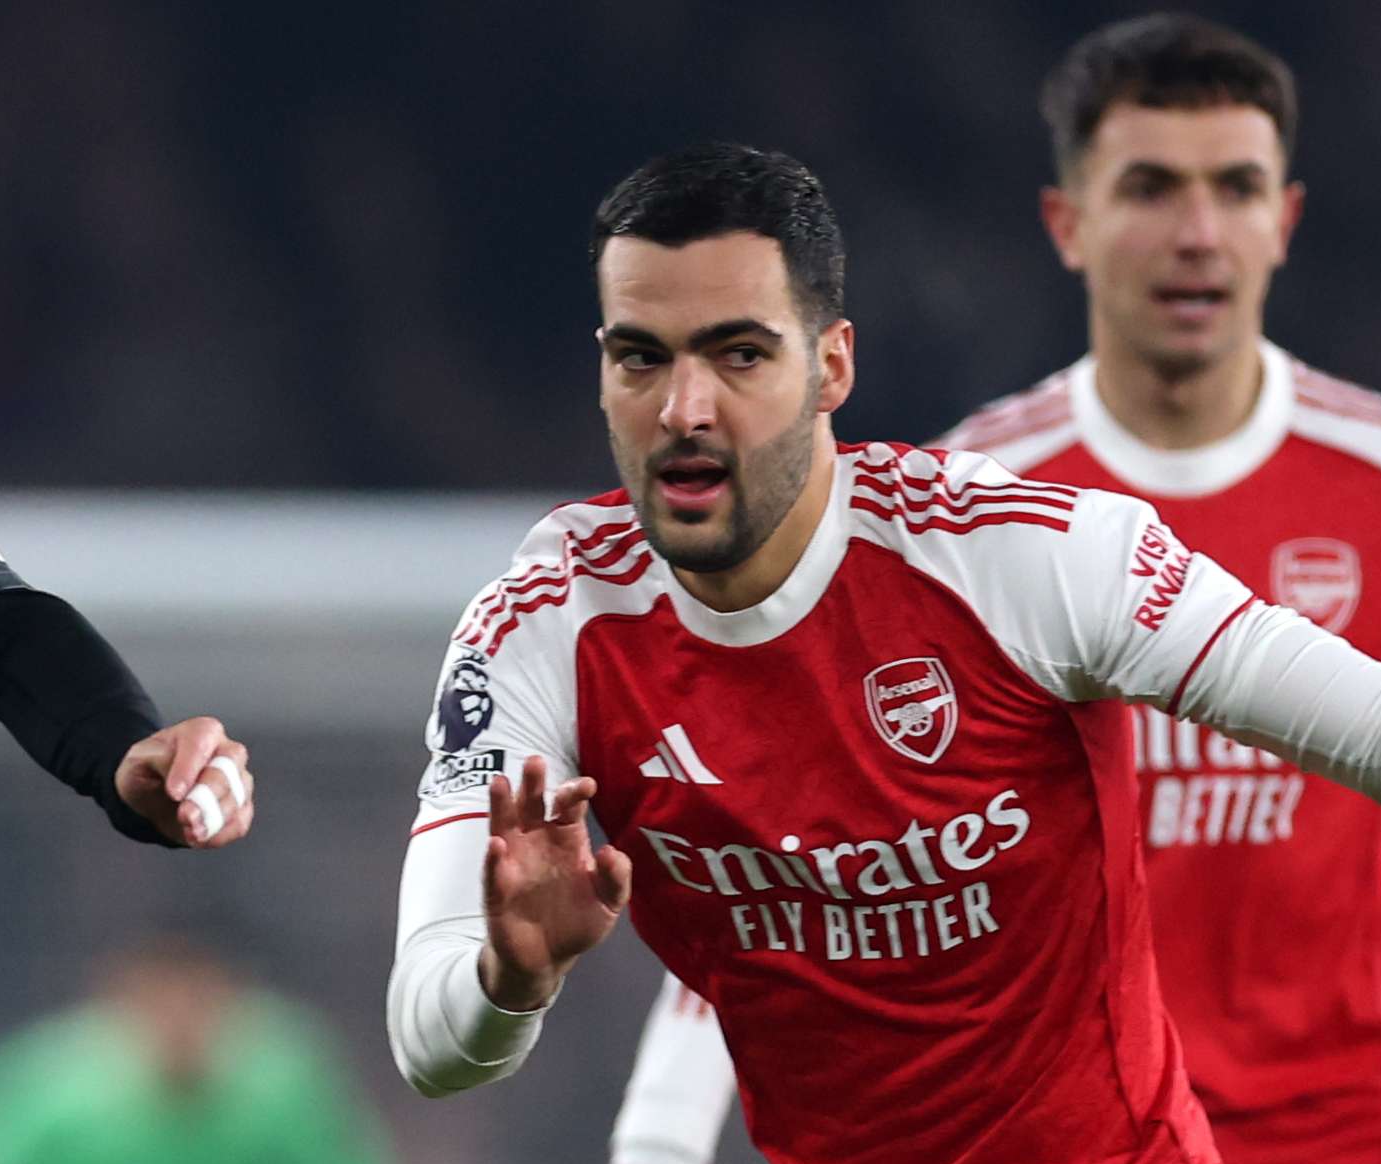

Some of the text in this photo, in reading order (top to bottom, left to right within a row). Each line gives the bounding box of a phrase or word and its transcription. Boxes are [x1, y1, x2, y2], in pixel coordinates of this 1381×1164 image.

[638, 789, 1031, 900] Emirates
[730, 881, 1000, 961] FLY BETTER
